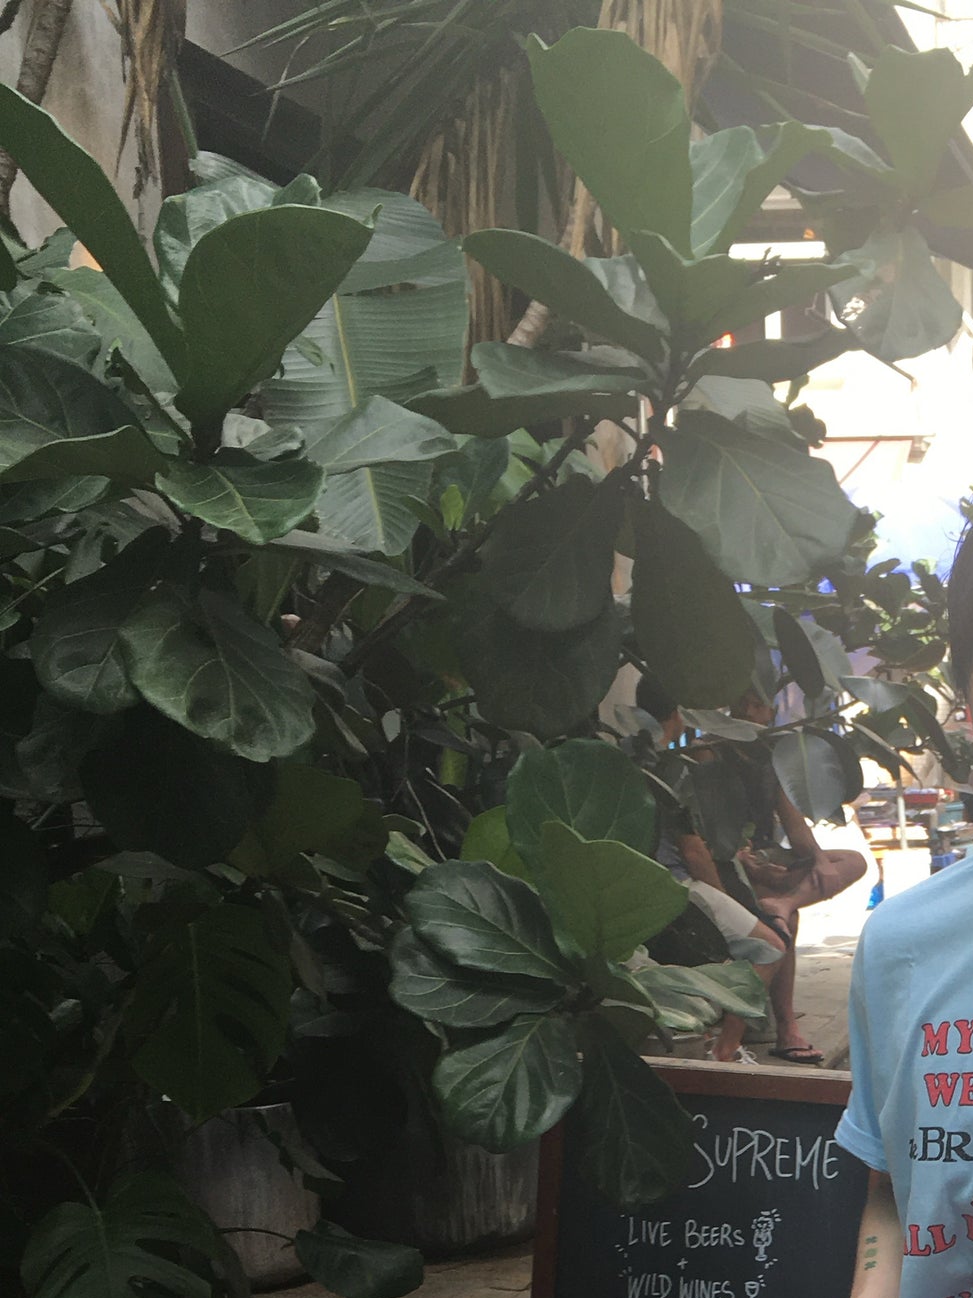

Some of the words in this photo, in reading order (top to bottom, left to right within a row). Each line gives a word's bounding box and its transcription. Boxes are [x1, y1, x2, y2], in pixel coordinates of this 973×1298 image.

[688, 1114, 840, 1190] SUPREME
[628, 1217, 672, 1247] LIVE
[685, 1219, 745, 1248] BEERS
[903, 1223, 957, 1257] LL
